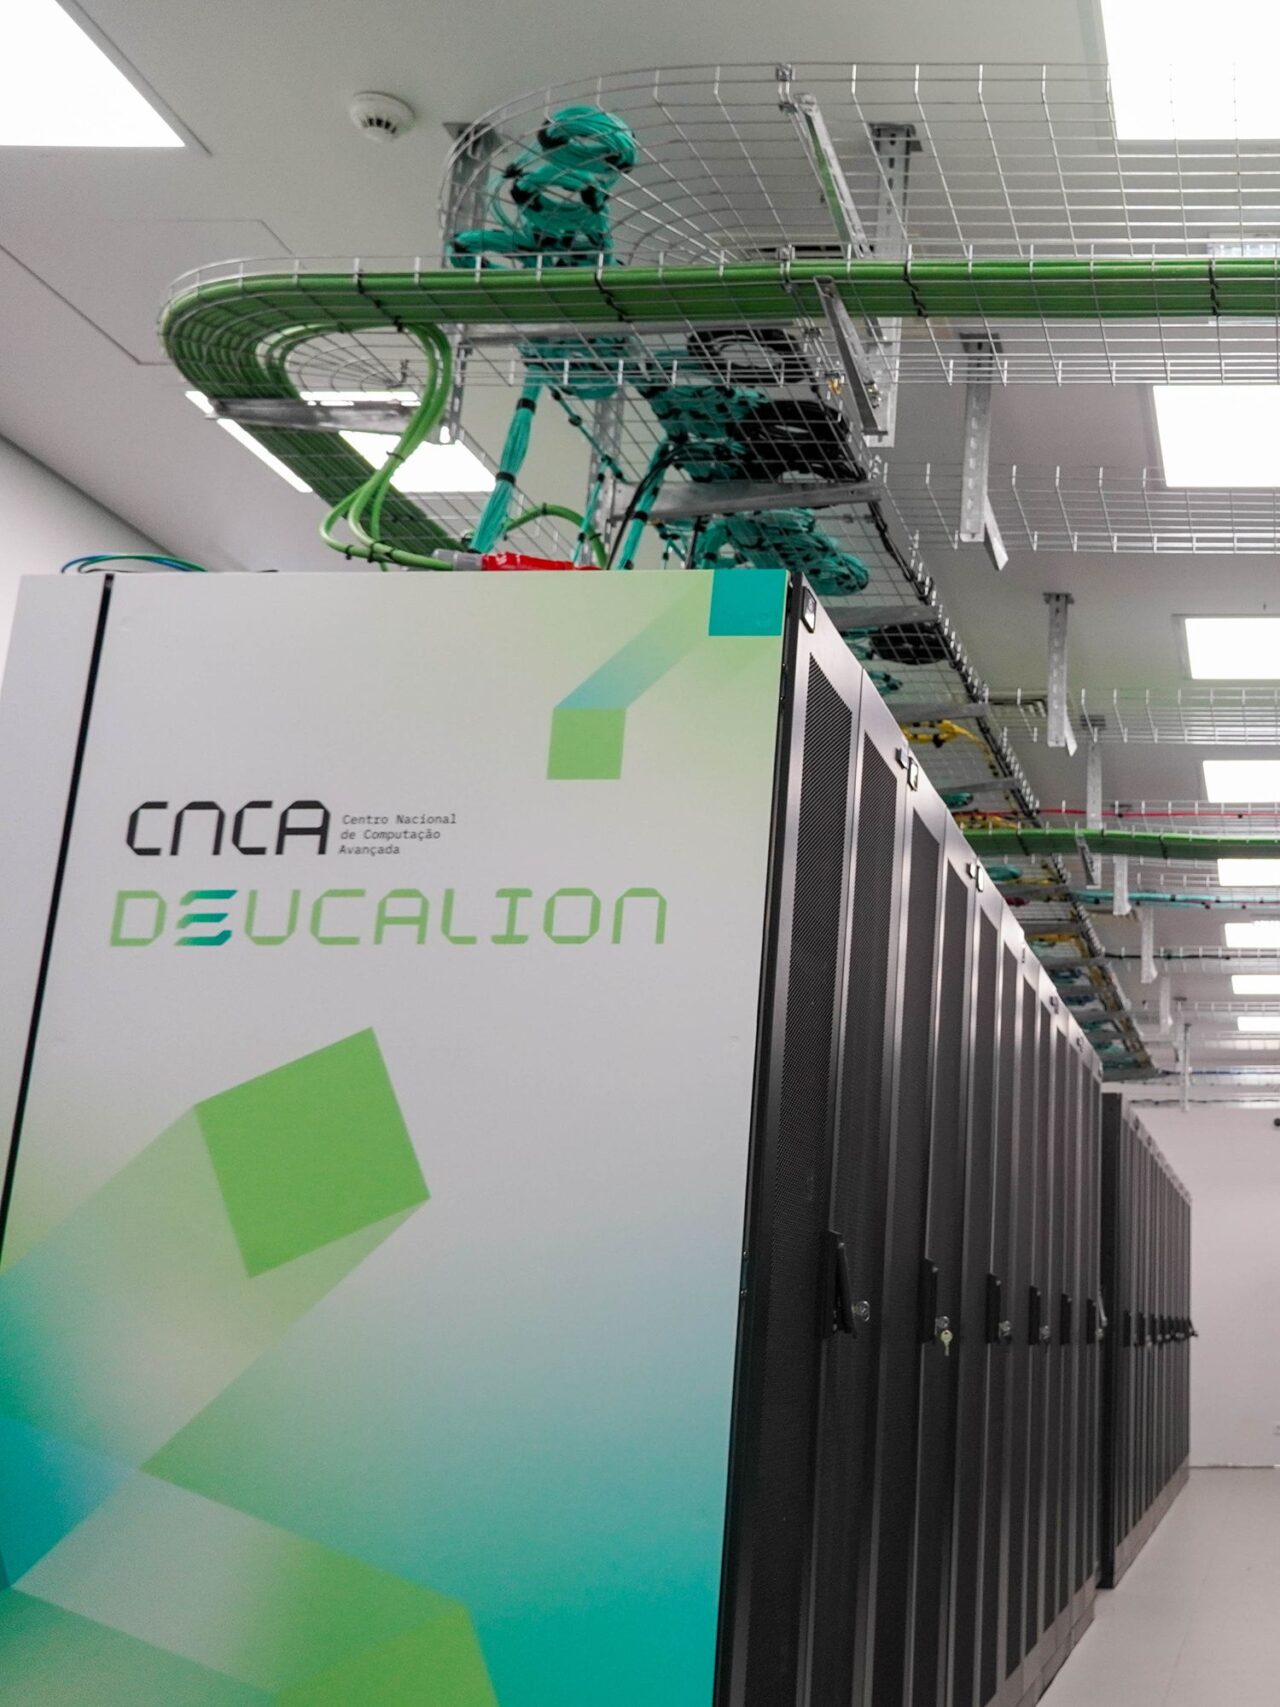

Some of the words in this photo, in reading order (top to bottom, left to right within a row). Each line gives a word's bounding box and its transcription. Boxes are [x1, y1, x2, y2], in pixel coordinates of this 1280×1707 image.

[342, 814, 389, 825] Centro
[396, 813, 457, 824] Nacional
[126, 800, 331, 856] CNCA
[340, 829, 356, 840] de
[363, 829, 441, 841] Computação
[338, 844, 400, 856] Avançada
[110, 887, 668, 946] DEUCALION
